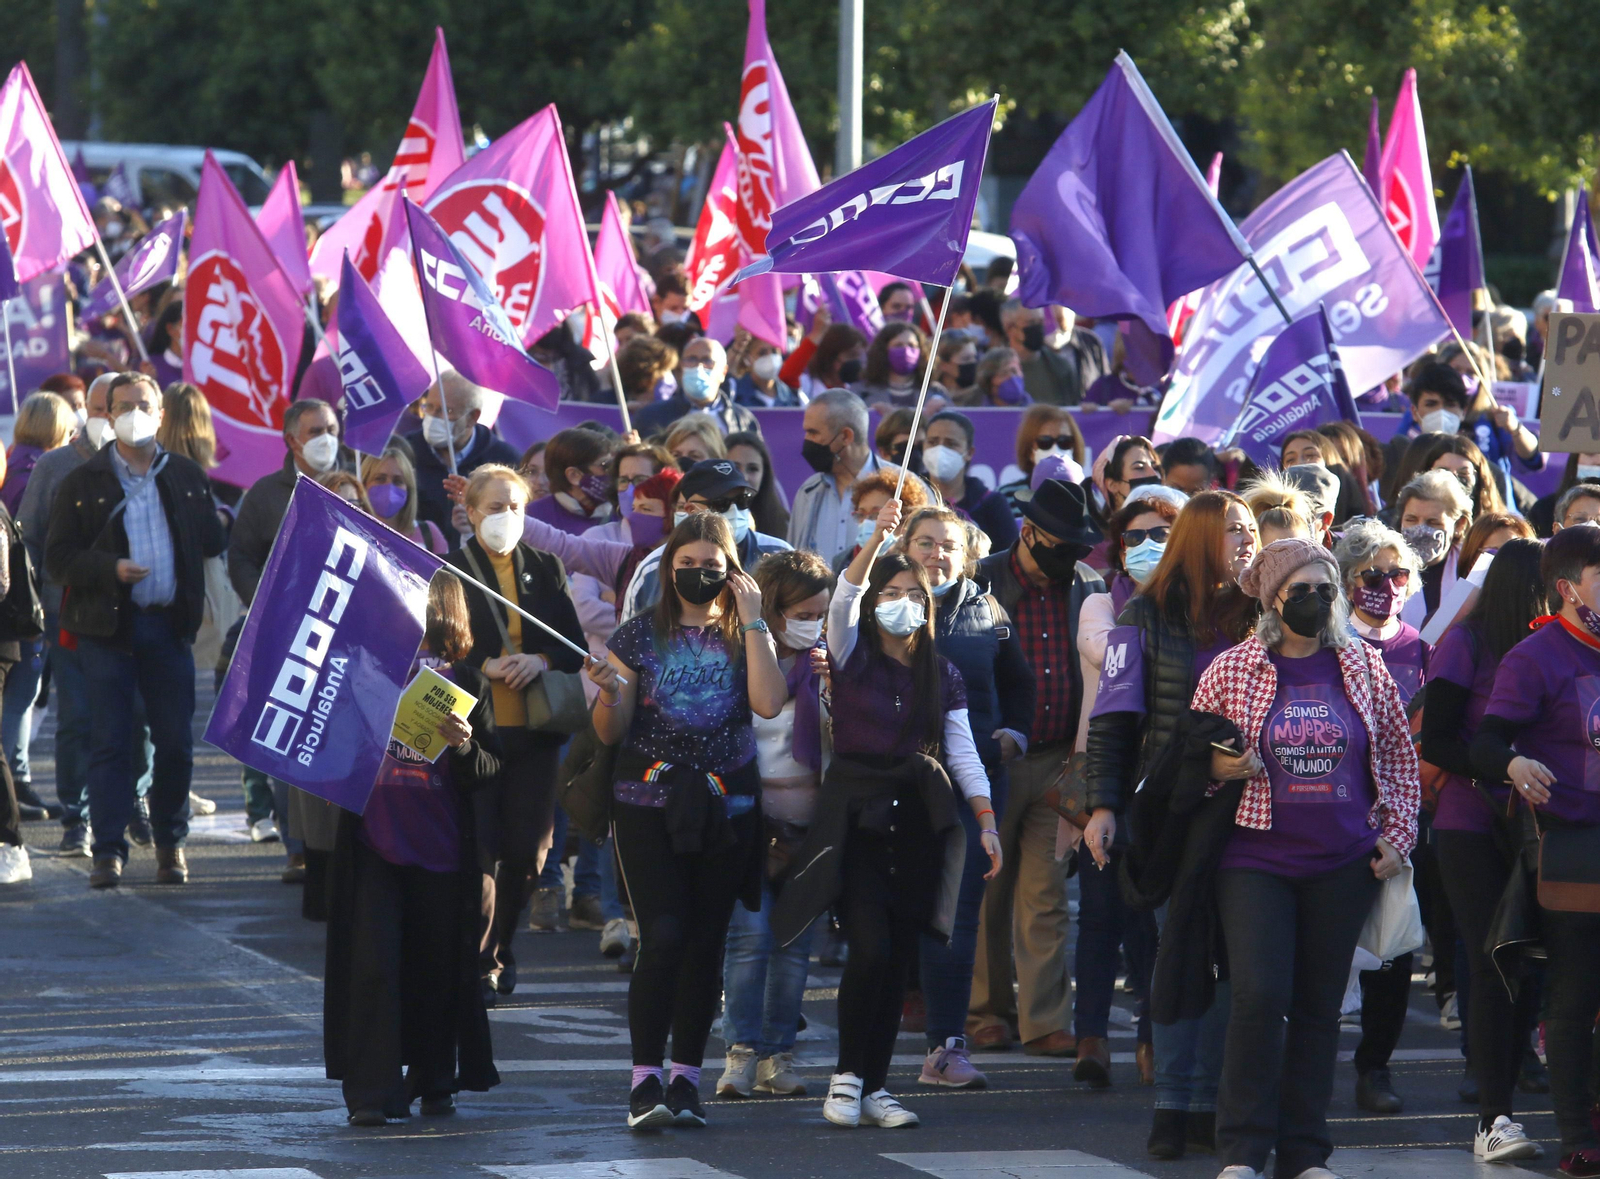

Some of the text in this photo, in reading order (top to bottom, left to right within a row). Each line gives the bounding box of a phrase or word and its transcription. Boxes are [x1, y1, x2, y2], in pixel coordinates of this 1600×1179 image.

[1555, 316, 1600, 366] PA
[422, 693, 453, 716] MUJERES
[430, 685, 457, 706] POR SER
[1284, 706, 1328, 718] SOMOS
[1275, 747, 1305, 756] SOMOS
[1281, 756, 1332, 774] DEL MUNDO
